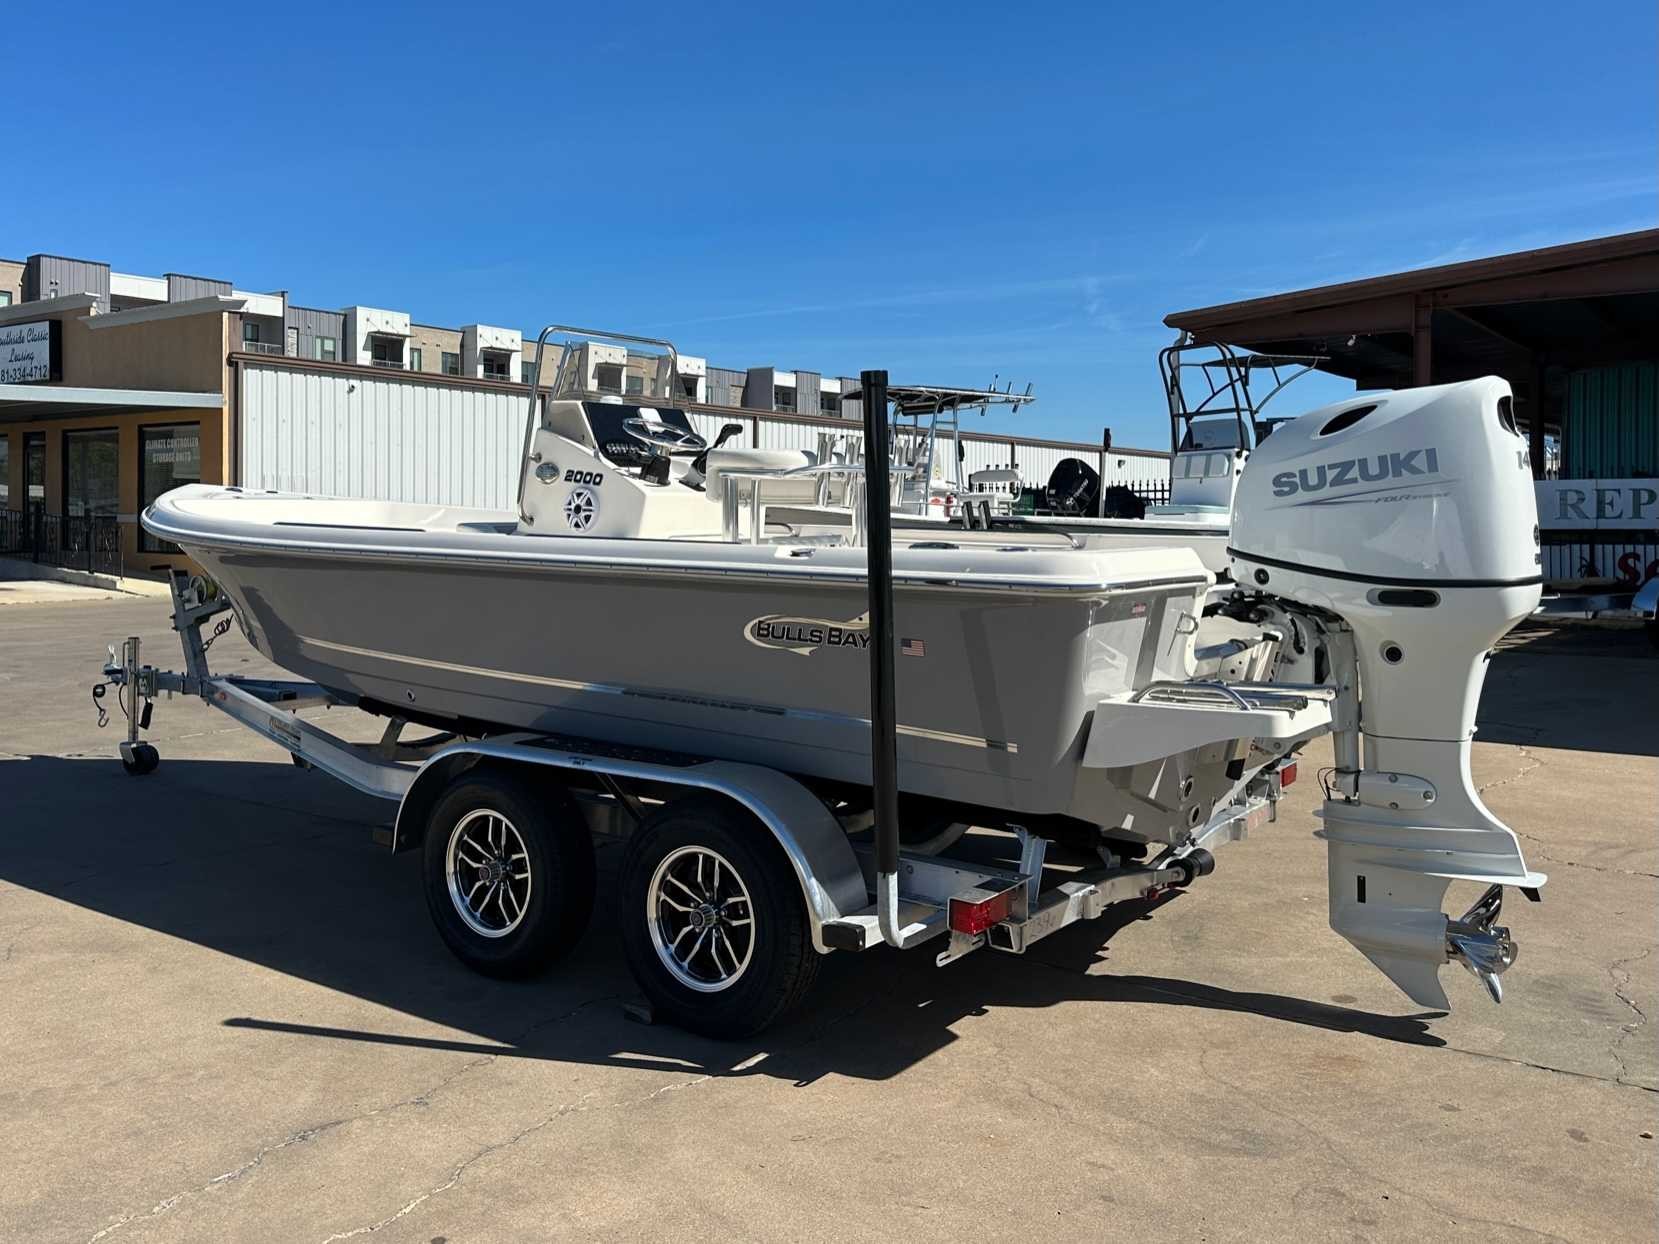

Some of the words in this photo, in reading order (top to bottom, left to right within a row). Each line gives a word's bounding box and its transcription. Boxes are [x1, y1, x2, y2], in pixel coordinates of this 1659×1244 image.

[0, 365, 48, 382] 81-334-4712
[1516, 450, 1531, 470] 14
[564, 469, 604, 486] 2000
[1272, 448, 1439, 498] SUZUKI
[1554, 488, 1659, 520] REP
[756, 620, 823, 644] BULLS
[826, 627, 870, 649] BAY
